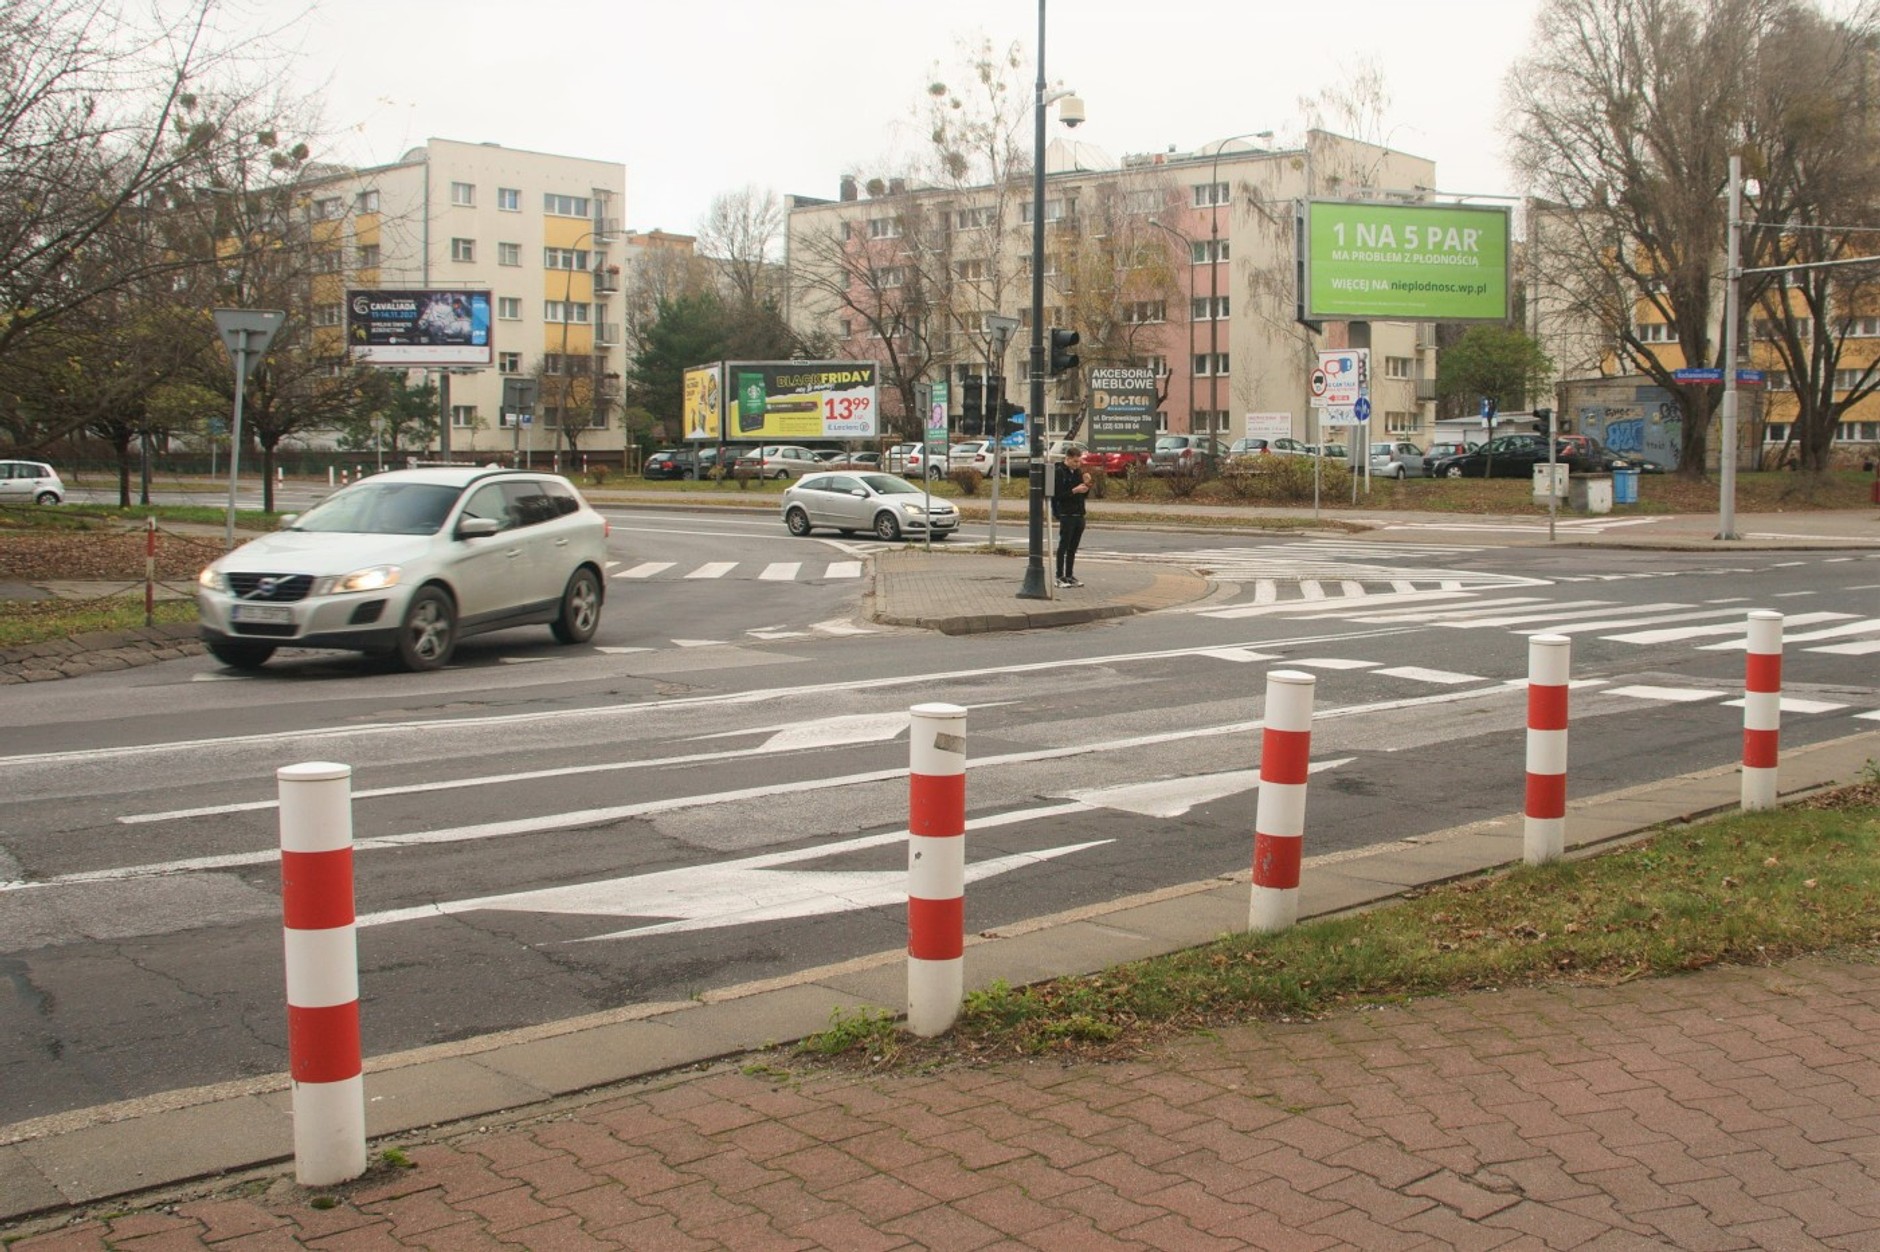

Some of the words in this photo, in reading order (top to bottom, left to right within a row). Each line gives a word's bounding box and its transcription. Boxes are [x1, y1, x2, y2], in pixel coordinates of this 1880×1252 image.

[1333, 222, 1344, 247] 1
[1356, 222, 1397, 248] NA
[1404, 225, 1419, 250] 5
[1332, 250, 1349, 261] MA
[1352, 251, 1402, 263] PROBLEM
[1404, 253, 1411, 263] Z
[1413, 252, 1479, 268] PŁODNOŚCIĄ
[1332, 278, 1370, 292] WIĘCEJ
[1372, 280, 1389, 290] NA
[1391, 281, 1487, 296] nieplodnosc.wp.pl
[370, 302, 417, 311] CAVALIADA
[1092, 369, 1154, 378] AKCESORIA
[1092, 379, 1154, 389] MEBLOWE
